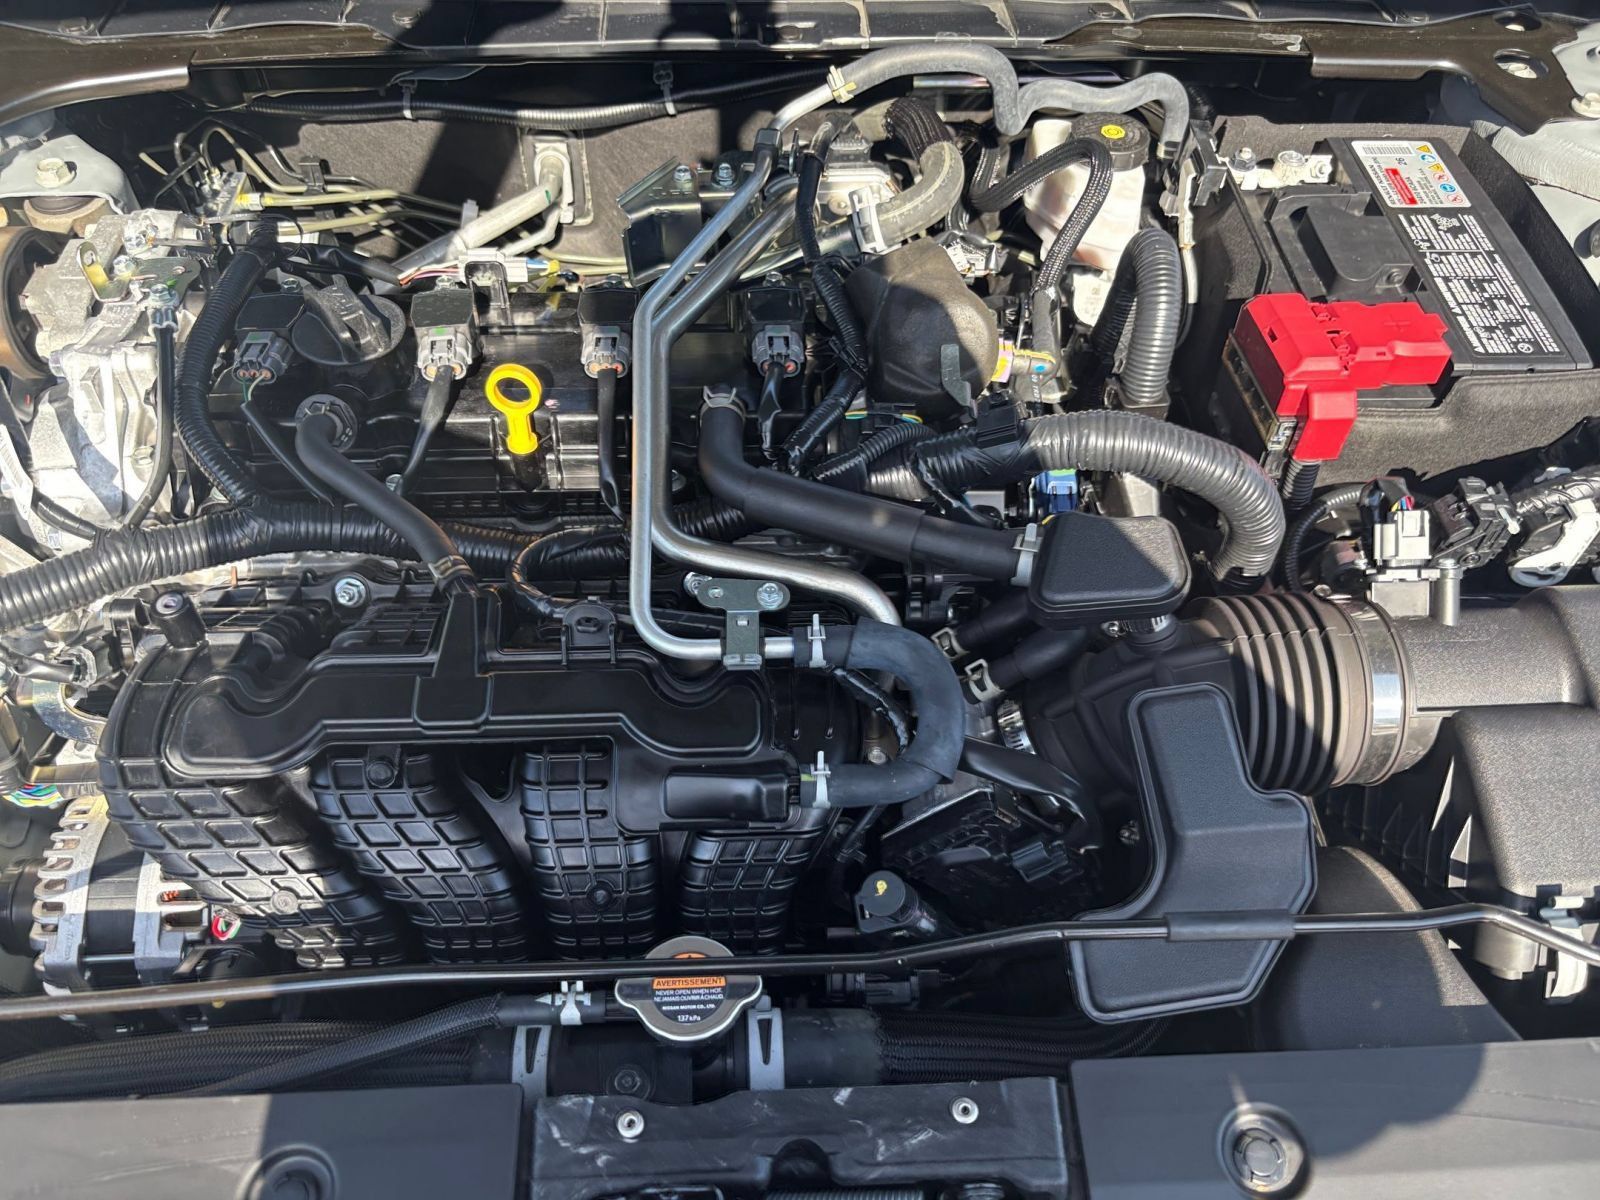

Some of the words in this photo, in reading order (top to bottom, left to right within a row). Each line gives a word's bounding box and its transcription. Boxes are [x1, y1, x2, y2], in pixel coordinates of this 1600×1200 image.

[1396, 158, 1408, 166] 26
[1369, 164, 1382, 184] NISSAN
[656, 977, 722, 986] AVERTISSEMENT
